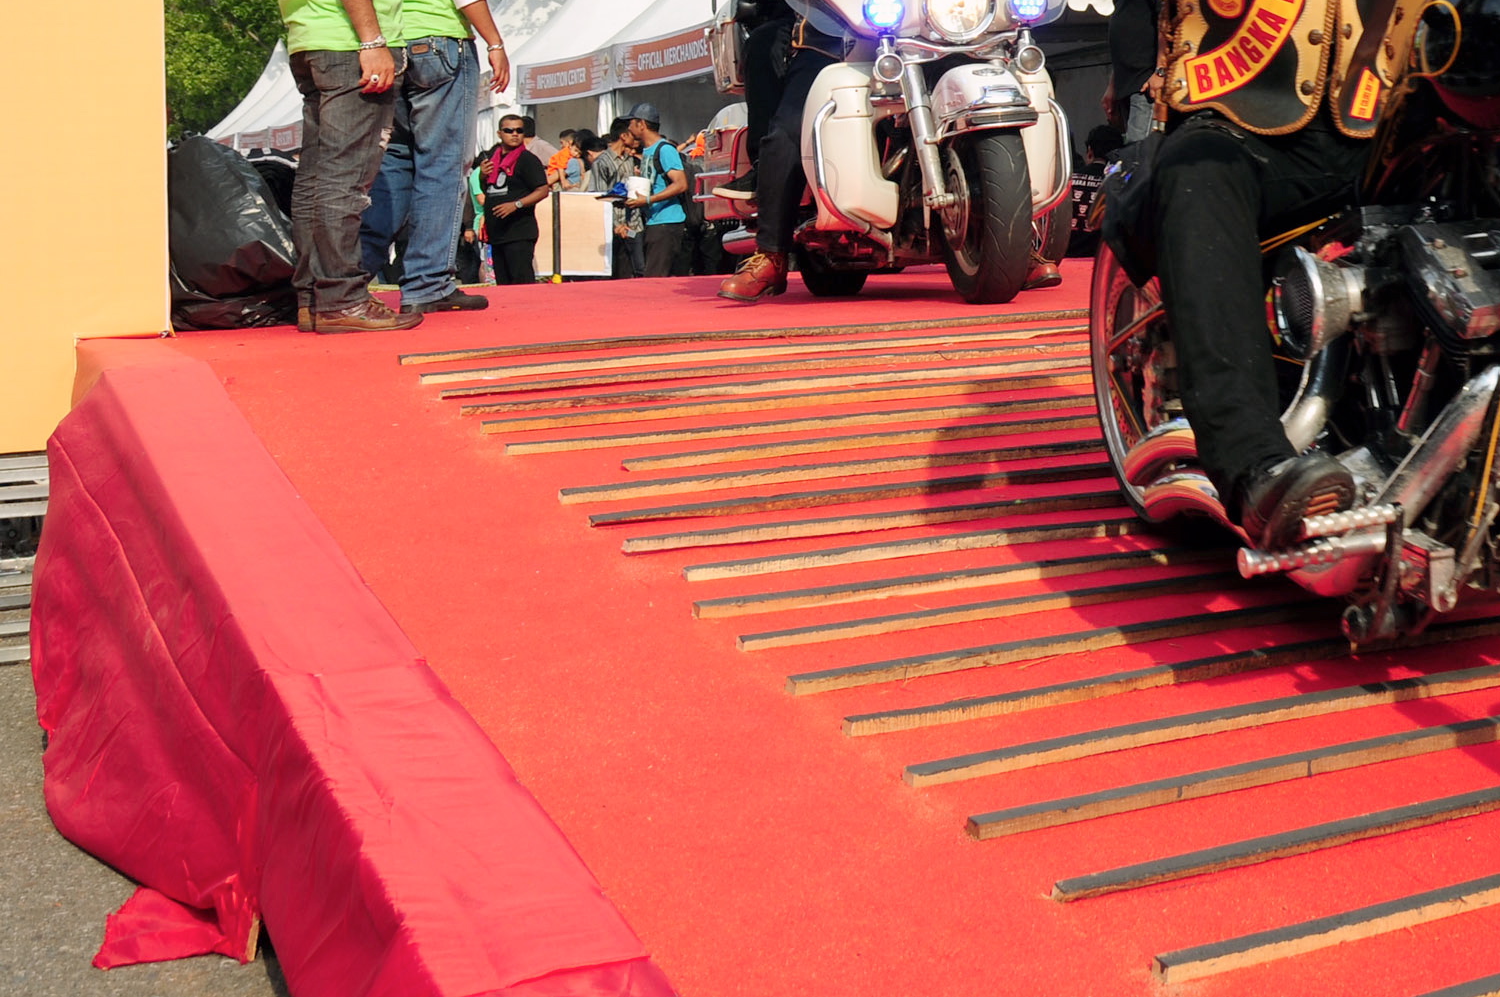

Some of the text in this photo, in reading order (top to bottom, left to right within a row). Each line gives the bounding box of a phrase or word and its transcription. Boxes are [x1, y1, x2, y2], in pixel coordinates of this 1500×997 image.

[637, 38, 709, 71] OFFICIAL MERCHANDISE
[1194, 8, 1288, 94] BANGKA
[537, 67, 586, 90] INFORMATION CENTER
